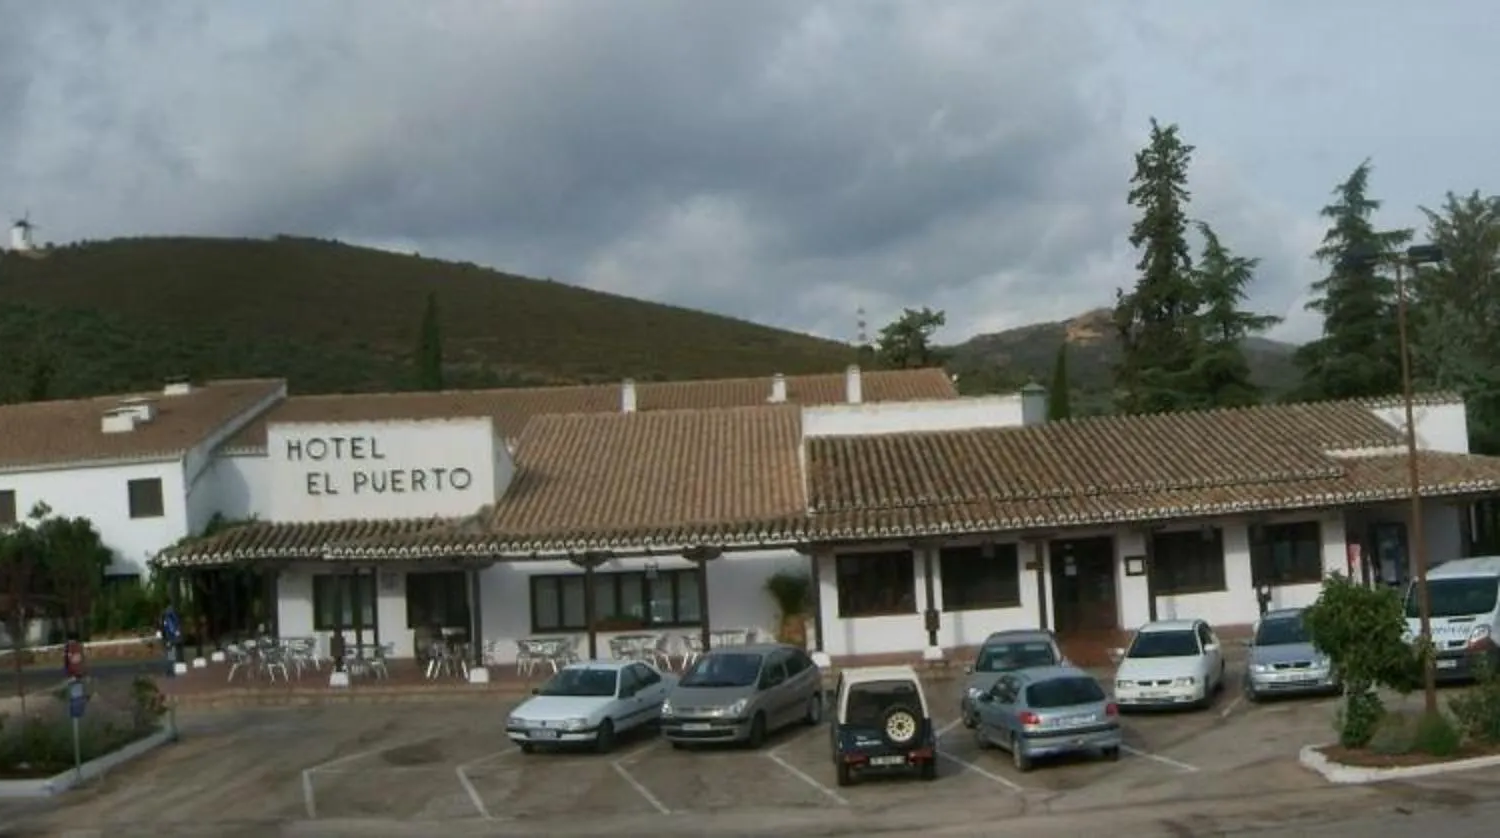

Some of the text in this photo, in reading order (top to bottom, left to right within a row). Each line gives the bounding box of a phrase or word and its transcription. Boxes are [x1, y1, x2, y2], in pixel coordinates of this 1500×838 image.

[286, 437, 385, 460] HOTEL
[306, 467, 472, 495] EL PUERTO
